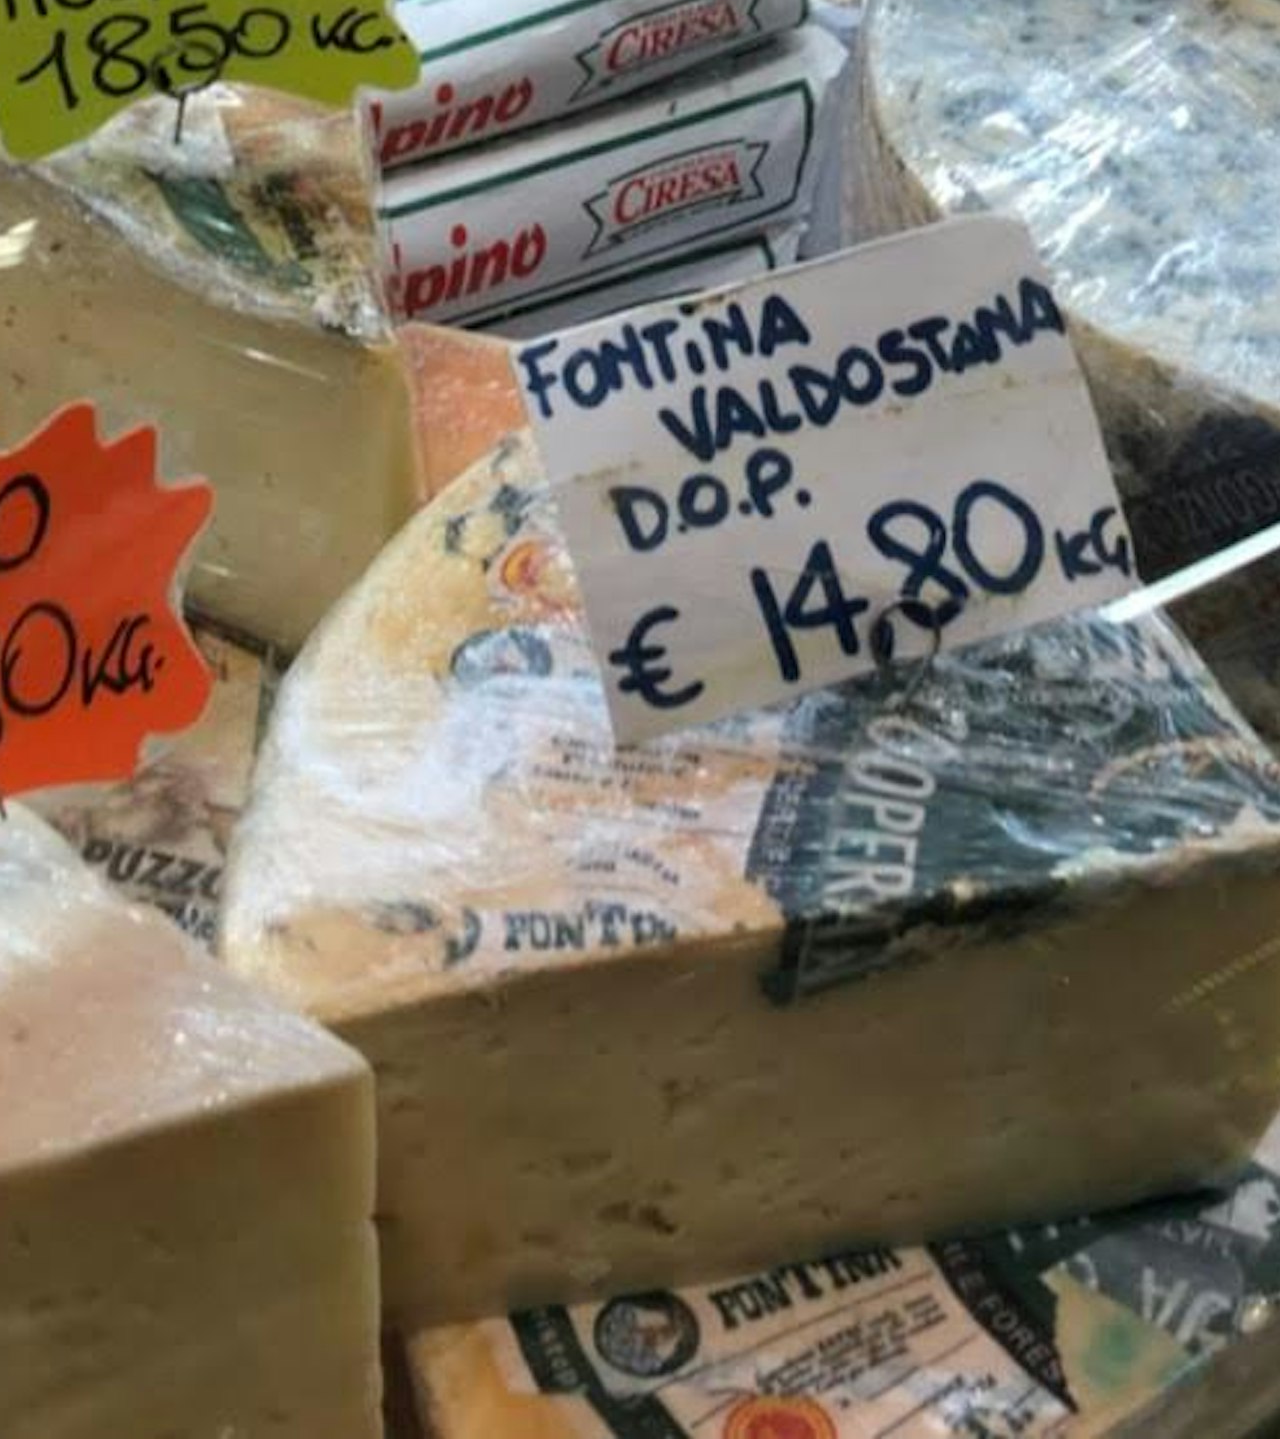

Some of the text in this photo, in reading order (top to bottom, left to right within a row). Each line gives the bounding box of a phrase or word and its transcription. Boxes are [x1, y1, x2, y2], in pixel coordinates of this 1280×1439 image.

[17, 5, 289, 110] 18,50
[608, 0, 740, 74] CIRESA
[613, 159, 741, 225] CIRESA
[520, 293, 811, 418] FONTINA
[659, 276, 1066, 462] VALDOSTANA
[609, 449, 814, 553] D.O.P.
[609, 605, 706, 710] €
[749, 480, 1046, 683] 14,80
